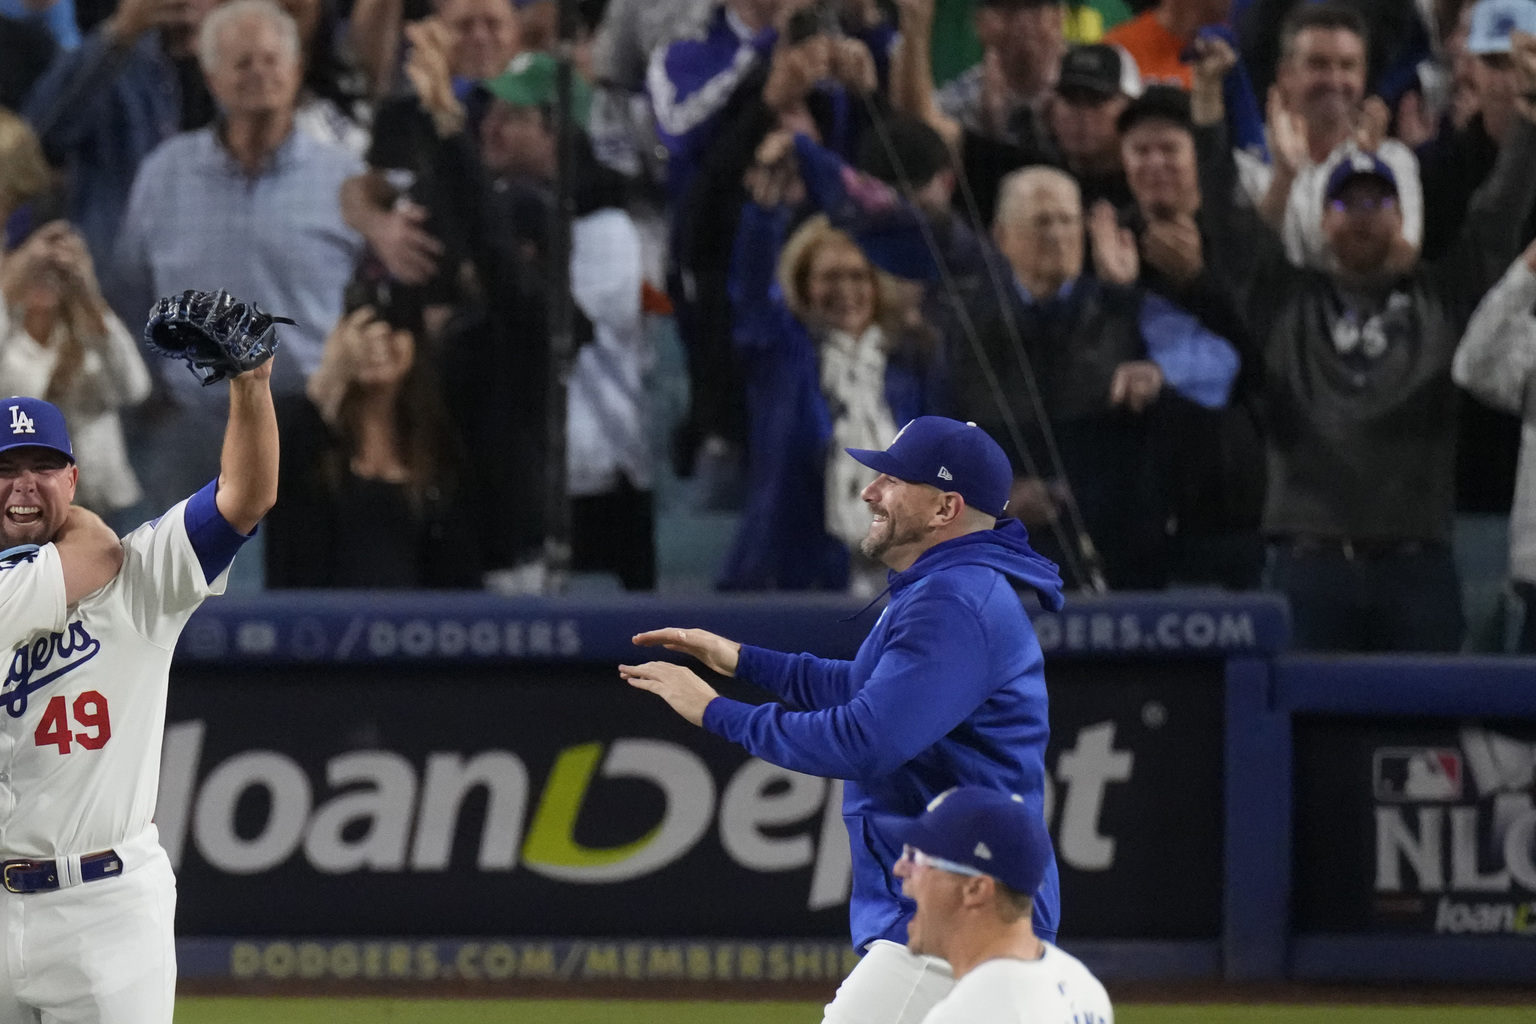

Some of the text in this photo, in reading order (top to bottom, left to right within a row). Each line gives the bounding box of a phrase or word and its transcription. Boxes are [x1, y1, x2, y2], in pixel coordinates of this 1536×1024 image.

[8, 405, 36, 434] LA
[1033, 612, 1256, 650] GERS.COM
[34, 690, 112, 755] 49
[154, 718, 1133, 912] loanDet
